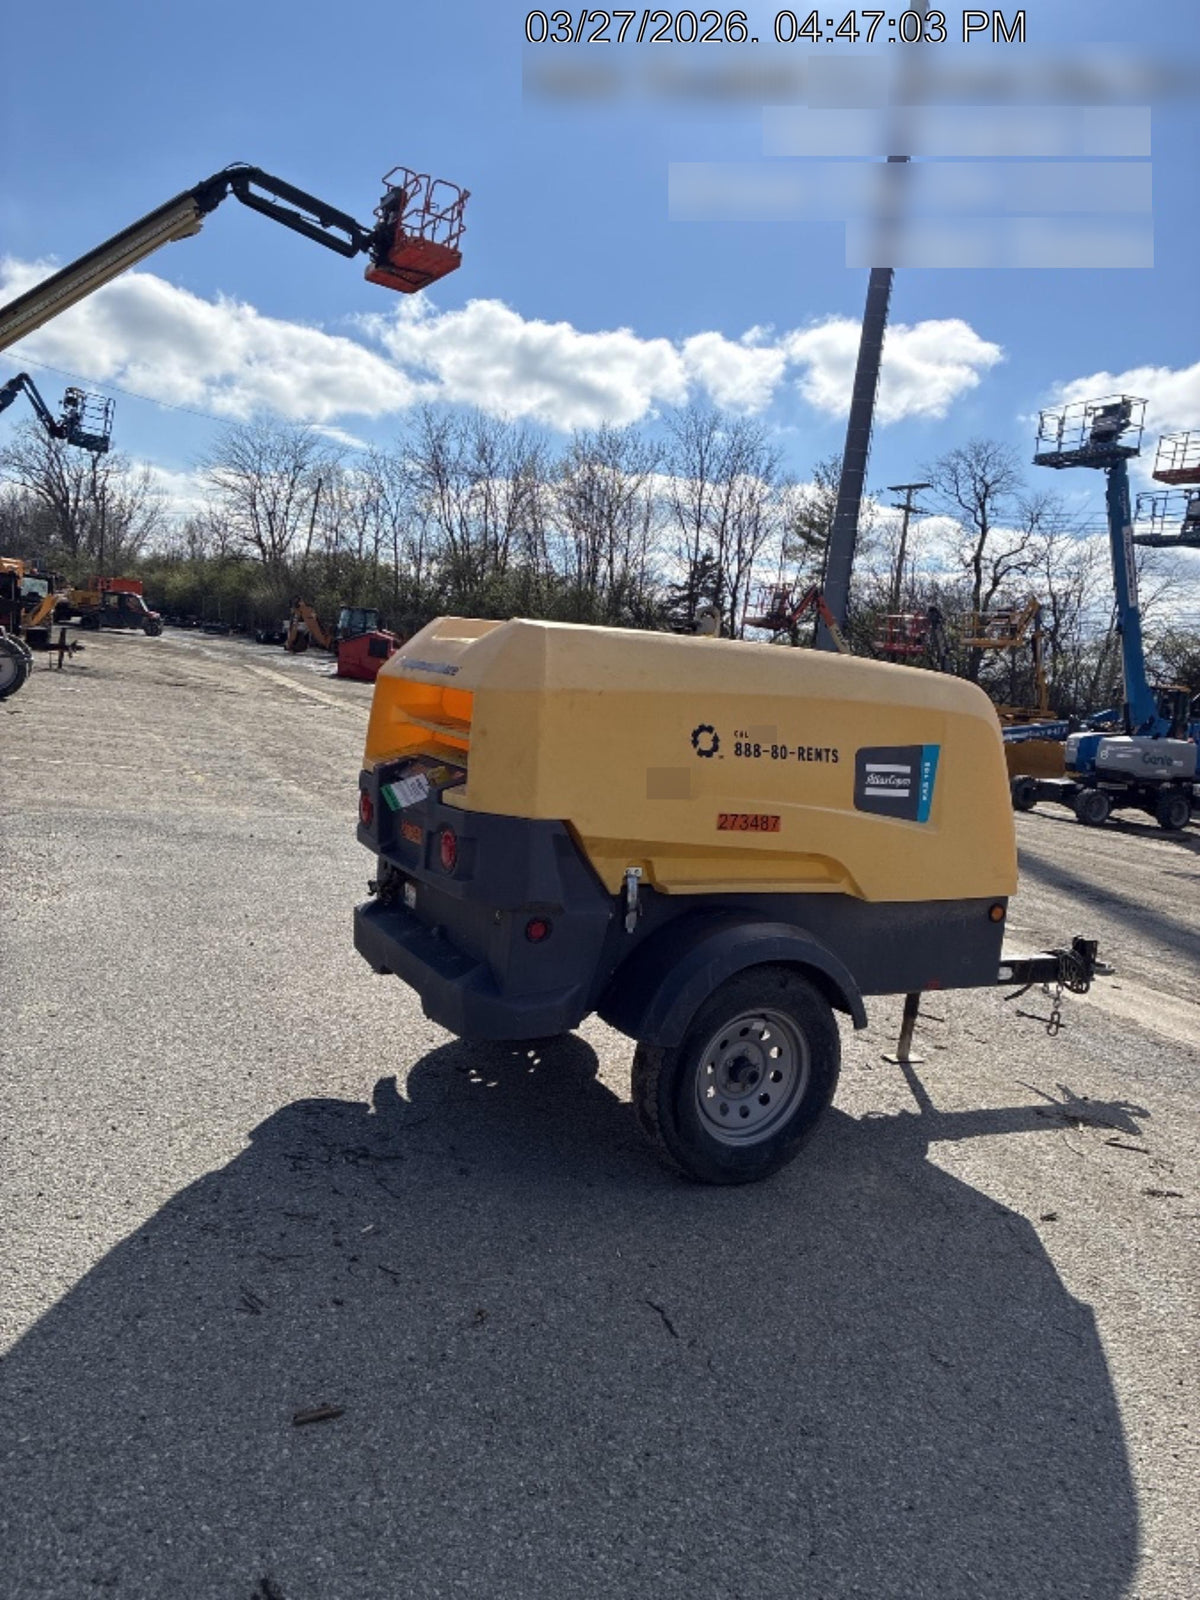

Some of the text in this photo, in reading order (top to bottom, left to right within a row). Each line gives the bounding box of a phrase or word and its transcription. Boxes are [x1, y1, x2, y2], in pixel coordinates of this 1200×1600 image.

[734, 742, 839, 763] 888-80-RENTS
[1142, 752, 1173, 766] Genie
[717, 813, 780, 831] 273487
